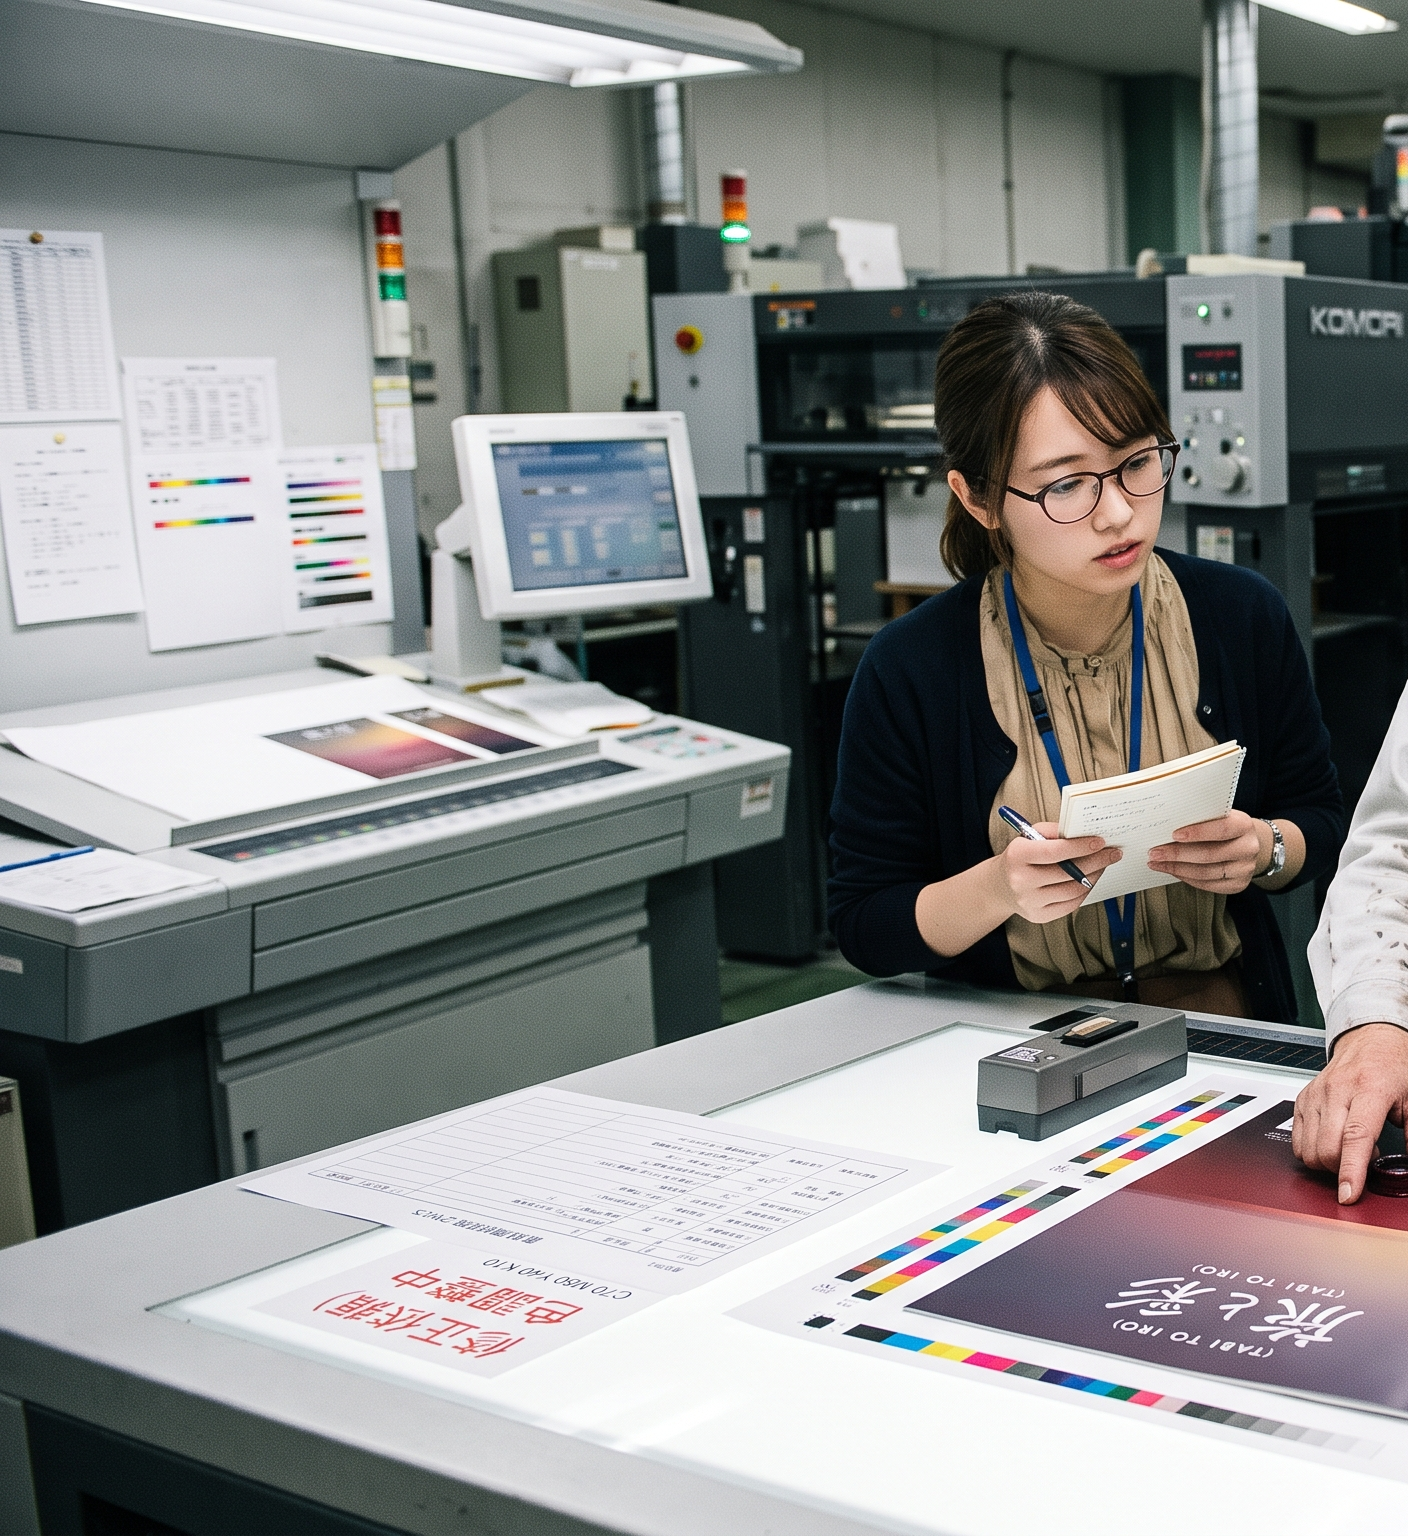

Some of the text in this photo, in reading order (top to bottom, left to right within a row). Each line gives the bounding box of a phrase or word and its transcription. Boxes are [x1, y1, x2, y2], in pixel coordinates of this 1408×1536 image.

[482, 1258, 521, 1272] K10
[1246, 1275, 1277, 1288] TO
[390, 1267, 584, 1327] 色調整中
[591, 1285, 632, 1301] C70
[1104, 1277, 1365, 1348] 旅と彩
[1169, 1331, 1202, 1346] TO
